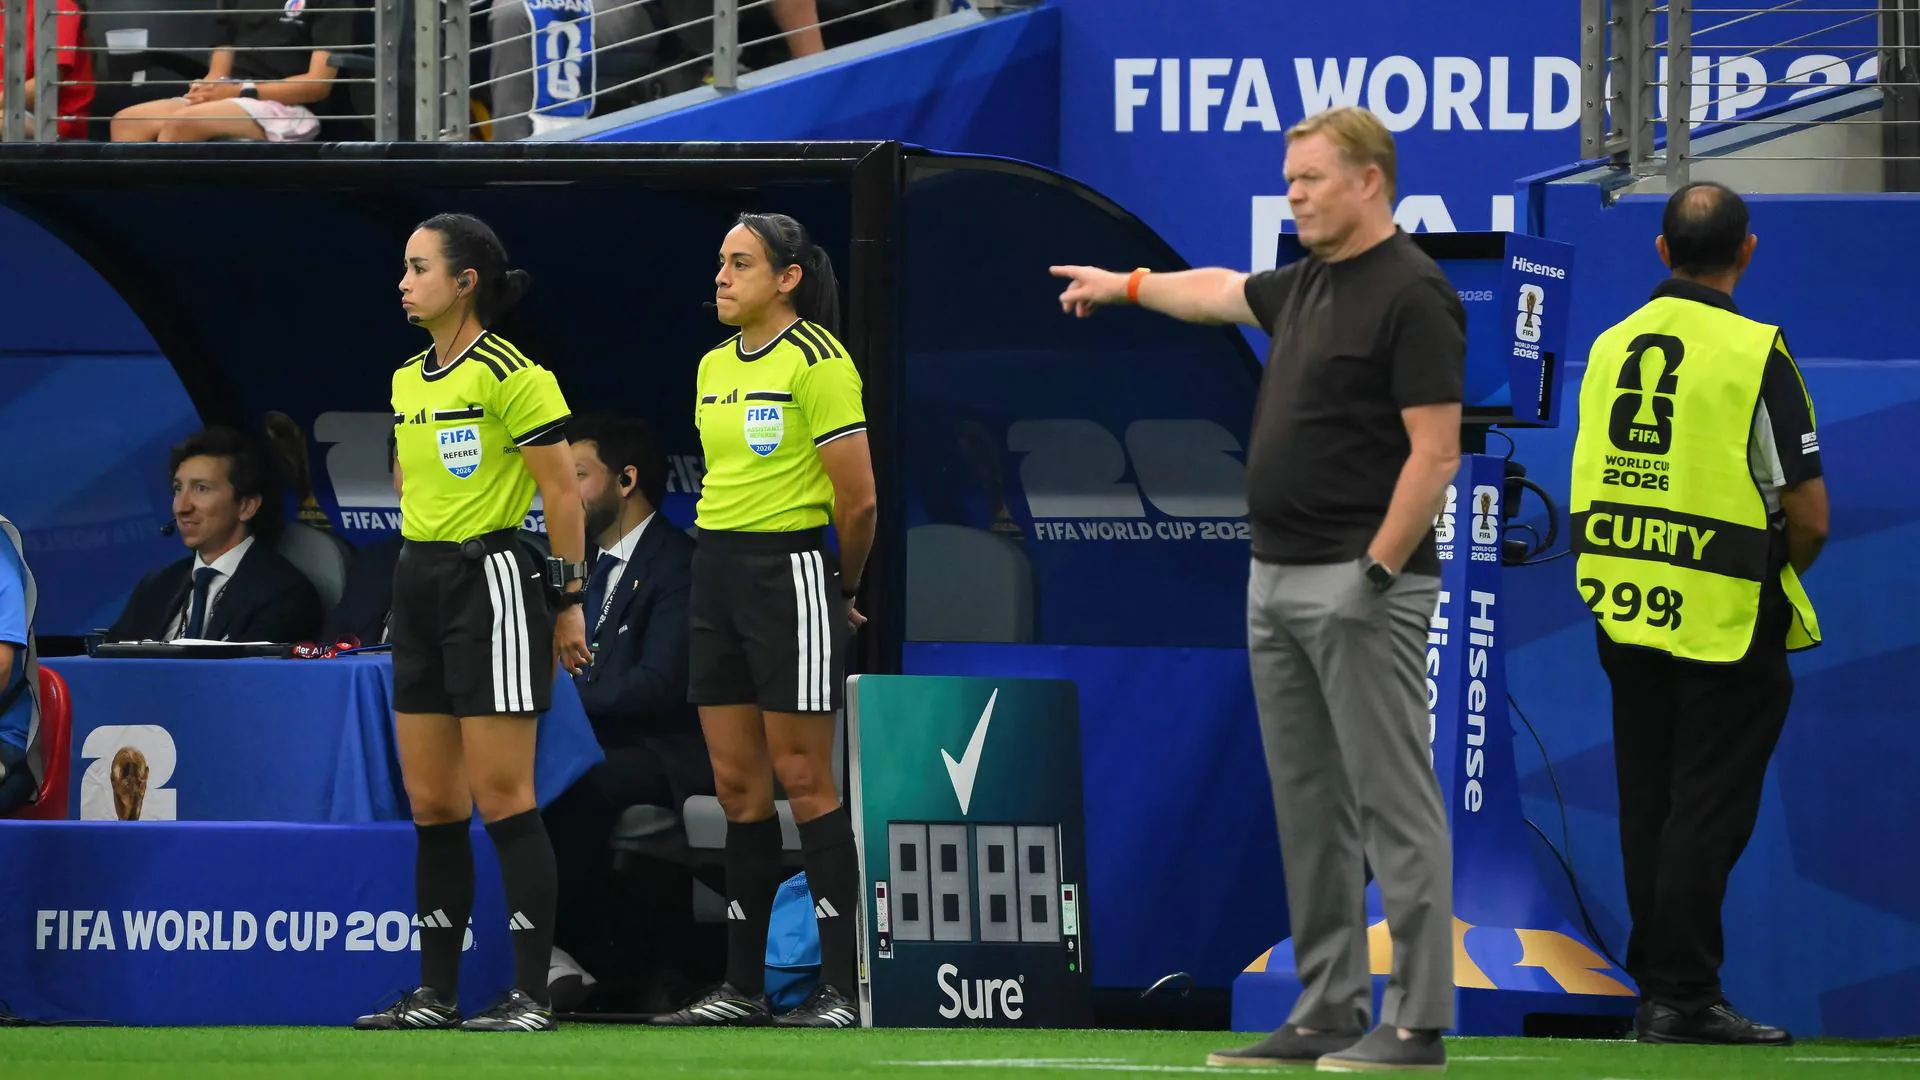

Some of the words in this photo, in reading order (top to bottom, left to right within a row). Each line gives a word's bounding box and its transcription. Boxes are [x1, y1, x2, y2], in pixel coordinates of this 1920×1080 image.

[1114, 58, 1281, 132] FIFA
[1294, 55, 1581, 132] WORLD
[1511, 256, 1565, 279] Hisense
[1522, 329, 1534, 337] FIFA
[1514, 341, 1530, 350] WORLD
[1513, 348, 1539, 360] 2026
[747, 408, 779, 421] FIFA
[440, 428, 476, 445] FIFA
[1629, 428, 1660, 444] FIFA
[443, 448, 478, 459] REFEREE
[1605, 455, 1651, 470] WORLD
[455, 467, 472, 475] 2026
[1602, 469, 1669, 491] 2026
[341, 511, 385, 530] FIFA
[1034, 522, 1079, 541] FIFA
[1078, 522, 1153, 541] WORLD
[1155, 522, 1195, 541] CUP
[1199, 522, 1250, 540] 202
[1479, 531, 1491, 540] FIFA
[1471, 552, 1497, 561] 2026
[1464, 590, 1496, 813] Hisense
[36, 910, 116, 950] FIFA
[122, 910, 258, 951] WORLD
[265, 910, 339, 952] CUP
[937, 963, 1024, 1020] Sure
